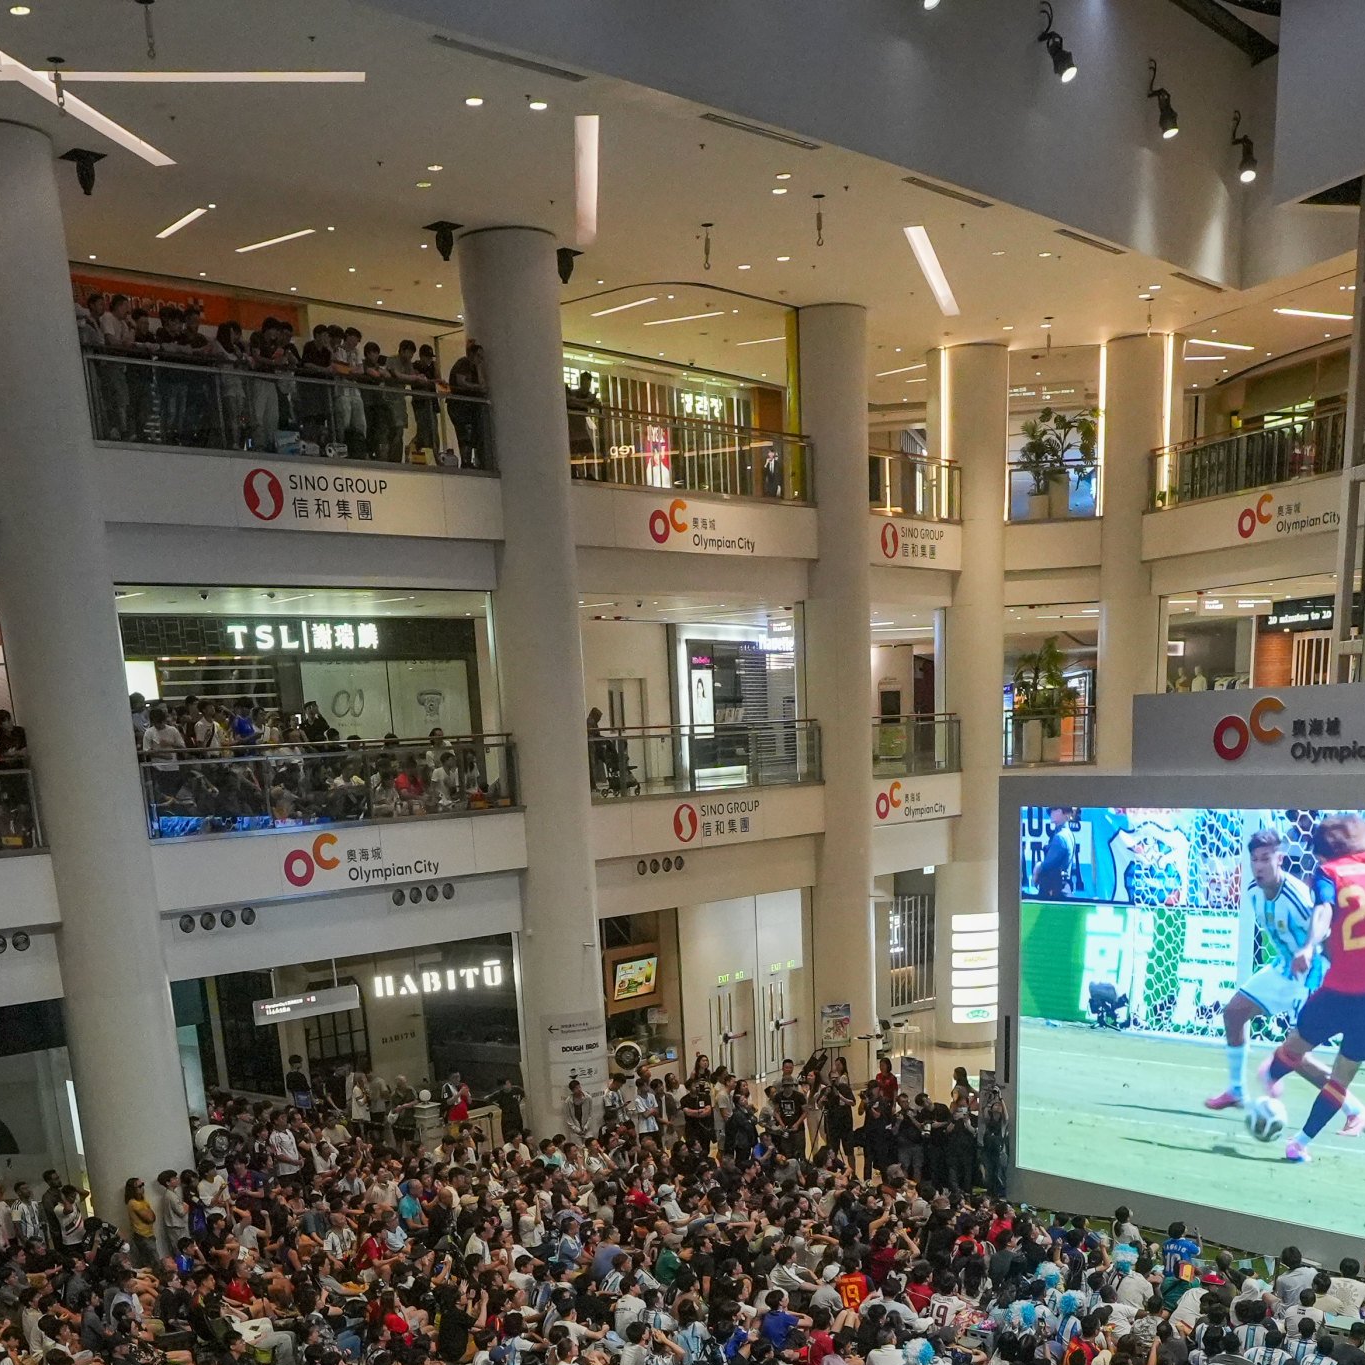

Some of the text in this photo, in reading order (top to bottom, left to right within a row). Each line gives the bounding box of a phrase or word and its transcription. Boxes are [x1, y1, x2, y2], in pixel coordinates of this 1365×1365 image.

[289, 473, 388, 497] SINO GROUP
[292, 497, 373, 522] 信和集團
[649, 499, 688, 543] OC
[1238, 493, 1273, 538] OC
[901, 526, 944, 541] SINO GROUP
[1276, 512, 1341, 533] Olympian City
[693, 533, 755, 552] Olympian City
[227, 625, 298, 650] TSL
[1213, 695, 1286, 761] OC
[701, 799, 760, 817] SINO GROUP
[876, 781, 902, 820] OC
[904, 803, 946, 818] Olympian City
[284, 833, 341, 887] OC
[348, 859, 440, 883] Olympian City
